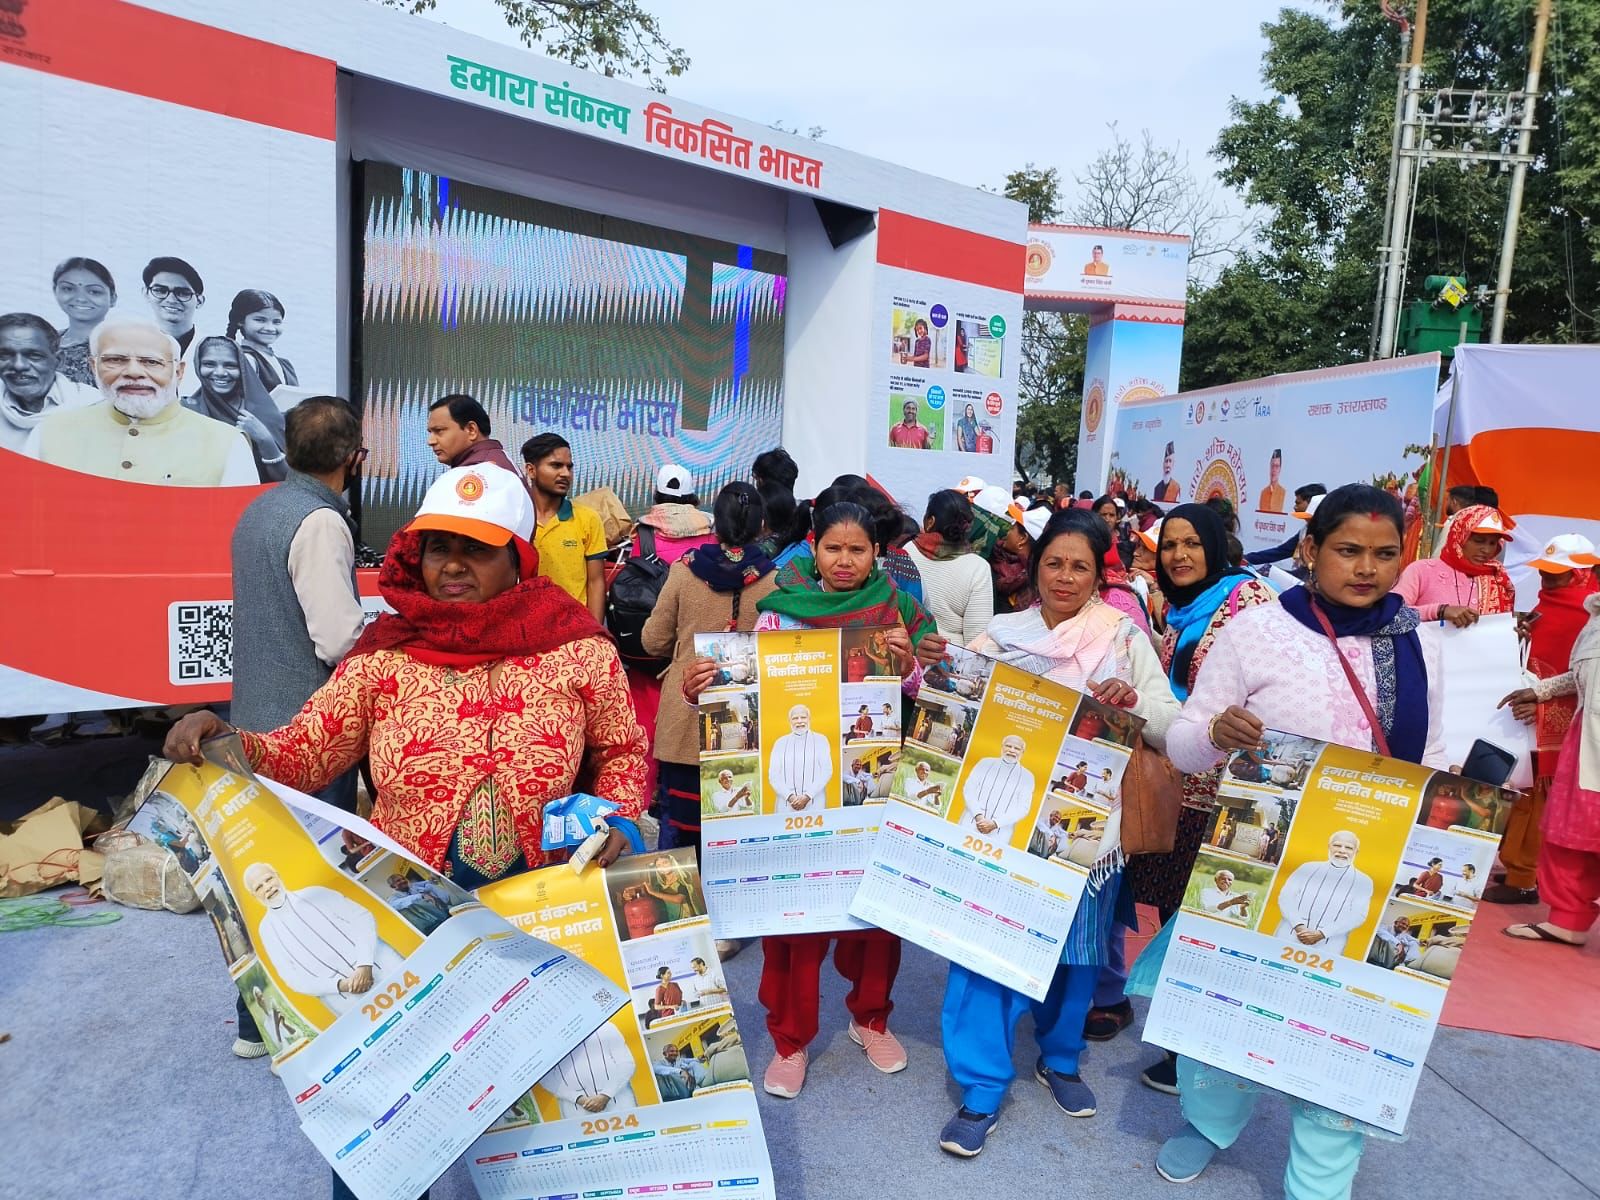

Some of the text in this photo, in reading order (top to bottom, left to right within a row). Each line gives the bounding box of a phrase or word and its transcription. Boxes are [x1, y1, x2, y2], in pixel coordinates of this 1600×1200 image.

[446, 54, 823, 189] हमारा संकल्प विकसित भारत
[616, 399, 677, 437] भारत
[1254, 404, 1271, 417] TARA
[764, 652, 791, 664] हमारा
[794, 650, 826, 662] संकल्प
[767, 664, 833, 678] विकसित भारत
[993, 693, 1035, 713] विकसित
[1036, 708, 1065, 722] भारत
[995, 683, 1025, 699] हमारा
[1026, 691, 1061, 710] संकल्प
[1321, 766, 1360, 780] हमारा
[1360, 771, 1407, 788] संकल्प
[1317, 777, 1411, 808] विकसित भारत
[785, 815, 824, 830] 2024
[962, 835, 1005, 861] 2024
[537, 900, 588, 921] संकल्प
[564, 917, 603, 936] भारत
[1280, 946, 1335, 973] 2024
[361, 970, 421, 1022] 2024
[581, 1113, 639, 1136] 2024
